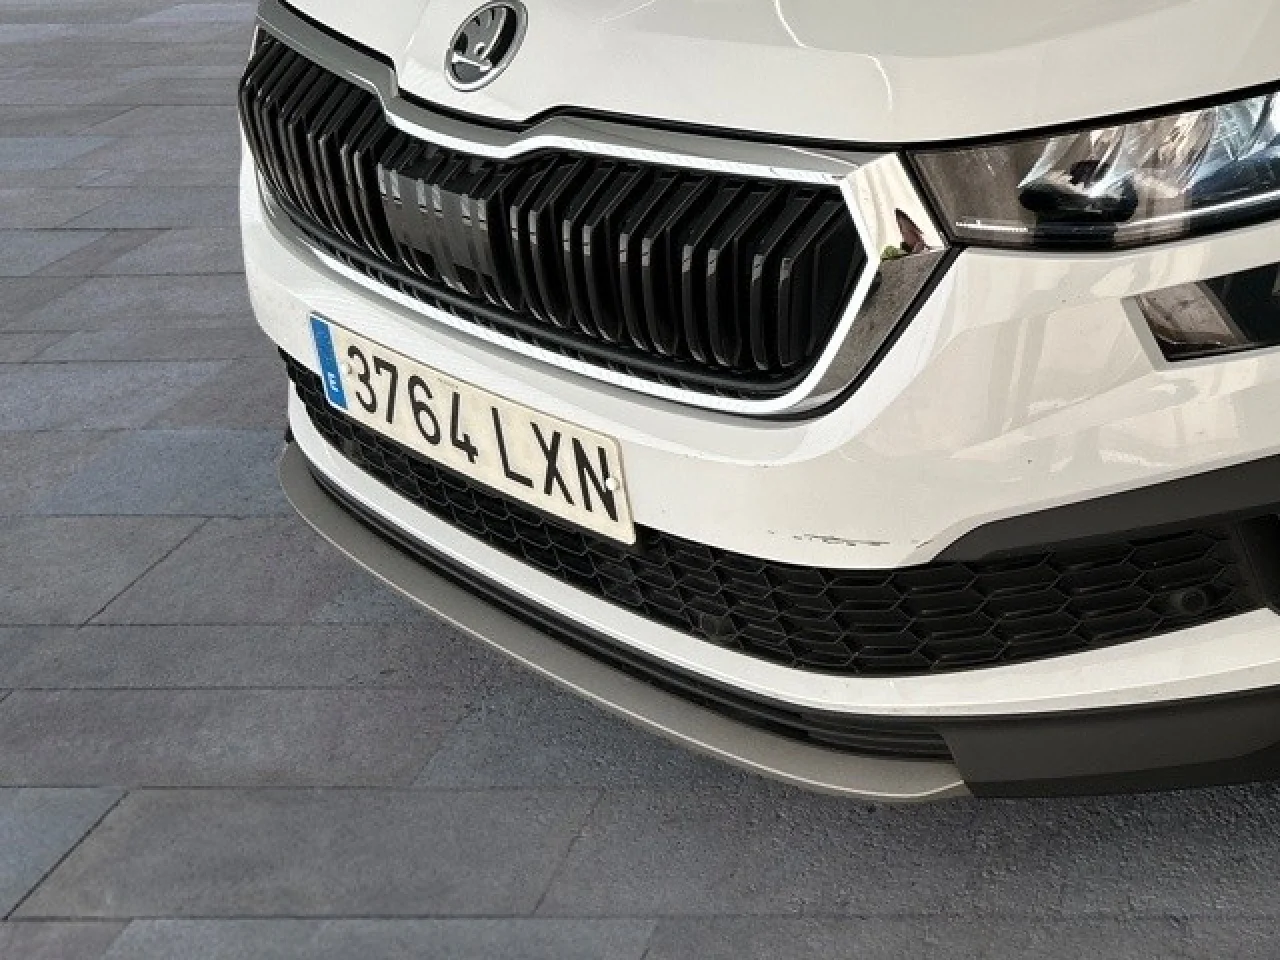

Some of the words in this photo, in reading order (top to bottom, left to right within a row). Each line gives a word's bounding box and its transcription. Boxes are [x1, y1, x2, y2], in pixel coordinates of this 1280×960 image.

[327, 371, 339, 393] E
[347, 345, 479, 464] 3764
[492, 406, 618, 522] LXN
